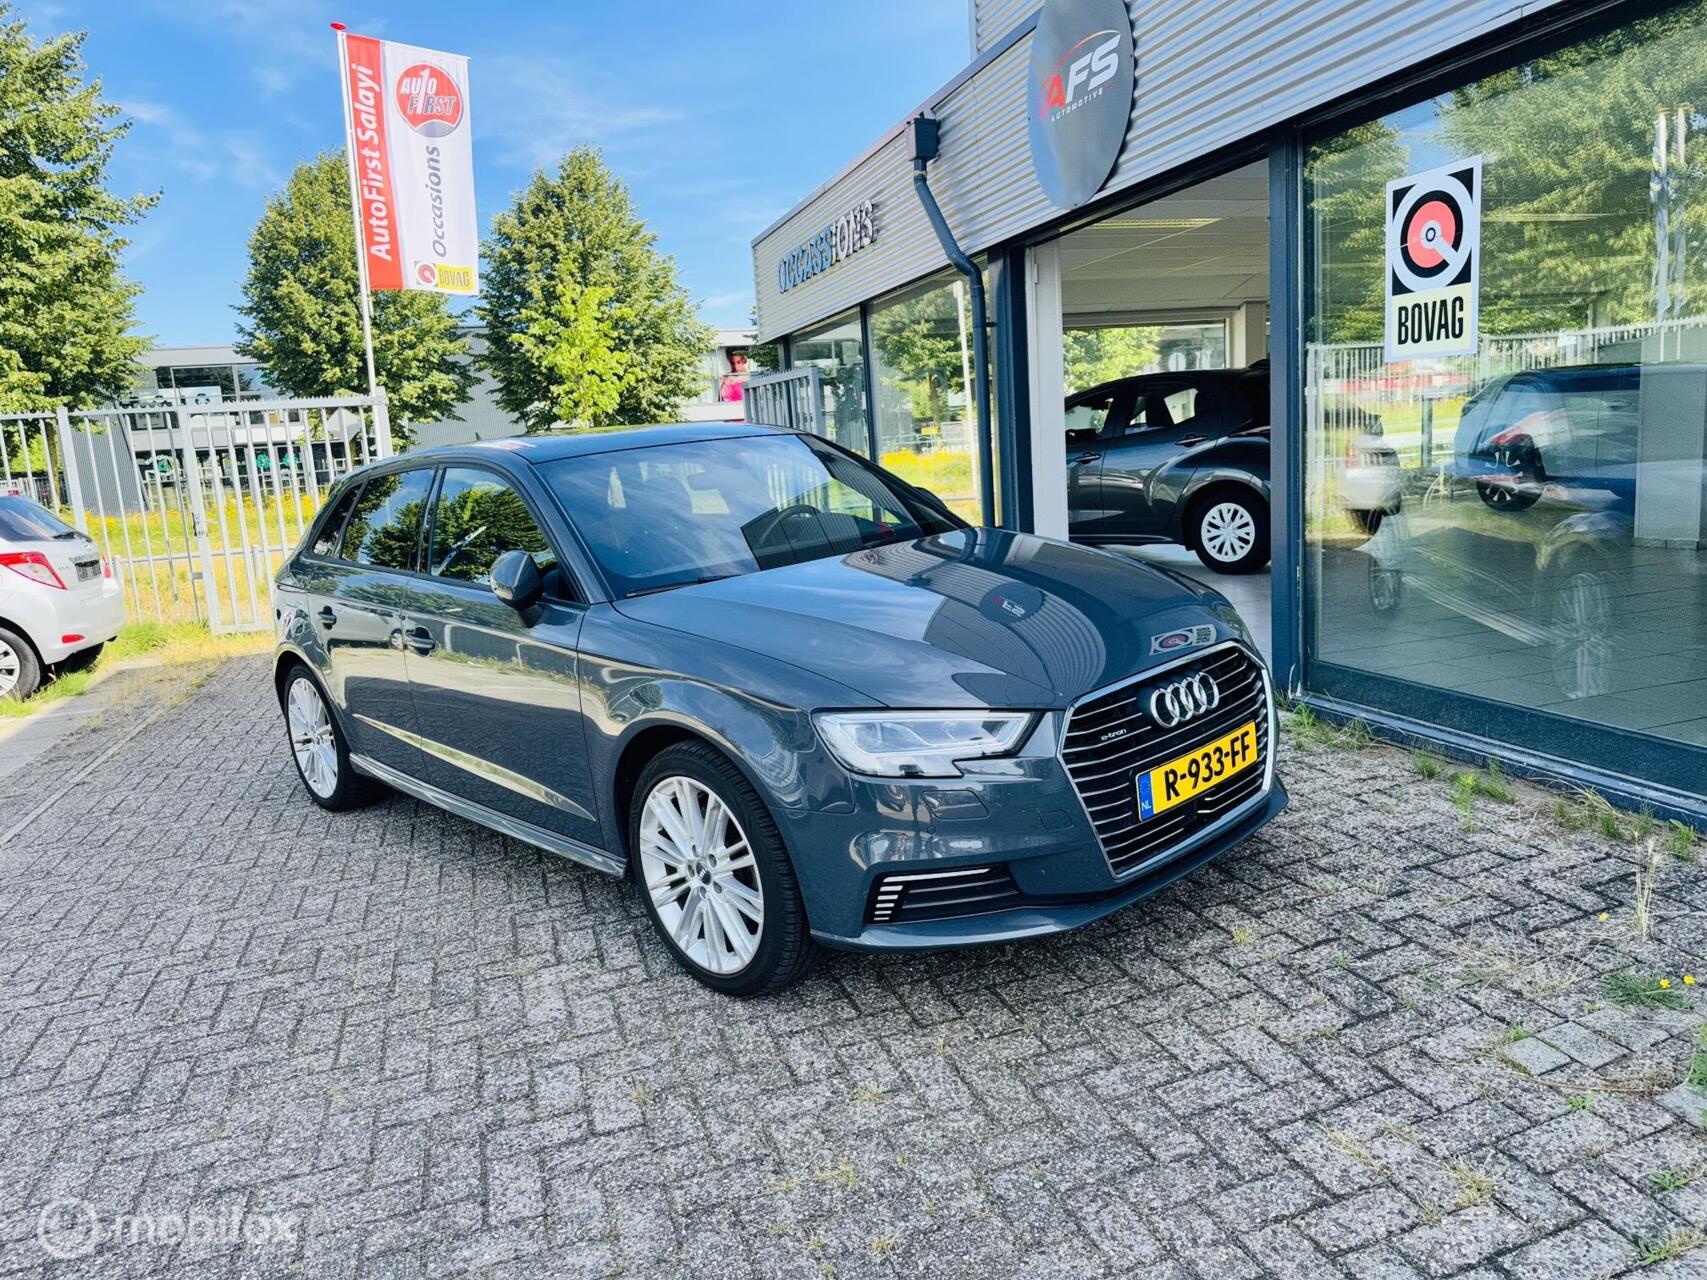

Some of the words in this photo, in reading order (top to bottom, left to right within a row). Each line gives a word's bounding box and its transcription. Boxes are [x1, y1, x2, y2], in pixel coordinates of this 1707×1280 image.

[352, 63, 381, 145] Salayi
[1040, 33, 1122, 120] AFS
[1051, 87, 1104, 122] AUTOMOTIVE
[360, 147, 392, 262] AutoFirst
[426, 145, 447, 258] Occasions
[438, 269, 470, 287] BOVAG
[1398, 296, 1464, 345] BOVAG
[1100, 728, 1127, 741] e-tron
[1164, 730, 1250, 802] R-933-FF
[1141, 800, 1152, 811] NL
